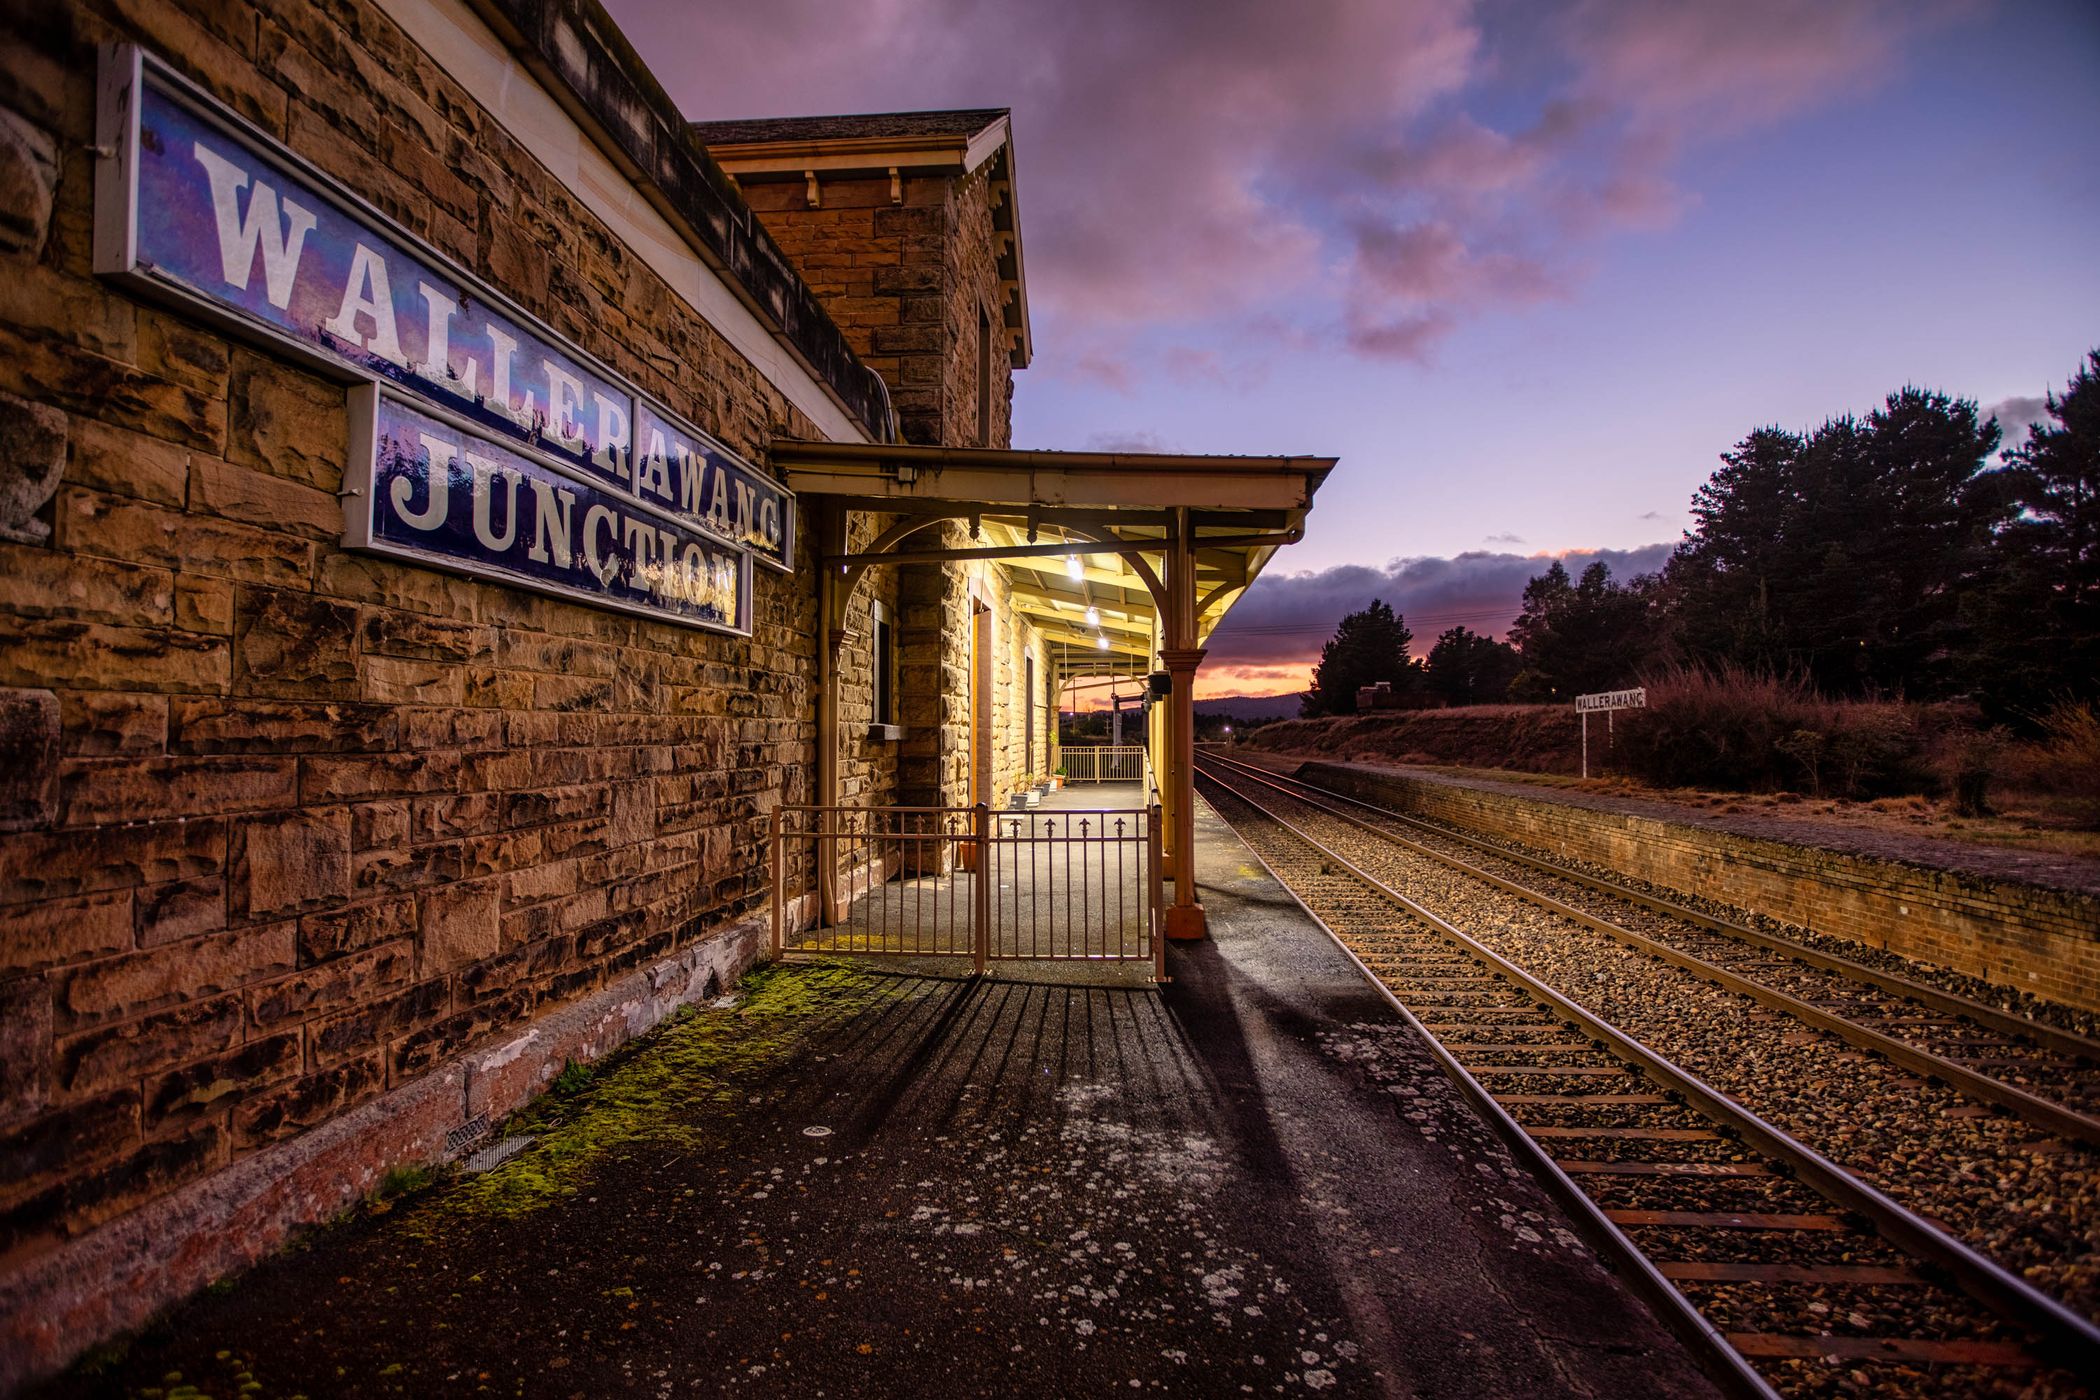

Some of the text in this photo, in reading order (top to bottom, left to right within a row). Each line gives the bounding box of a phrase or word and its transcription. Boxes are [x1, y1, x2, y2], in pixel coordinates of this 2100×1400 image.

[194, 141, 779, 549] WALLERAWANG
[390, 432, 736, 627] JUNCTION
[1577, 692, 1643, 709] WALLERAWANG
